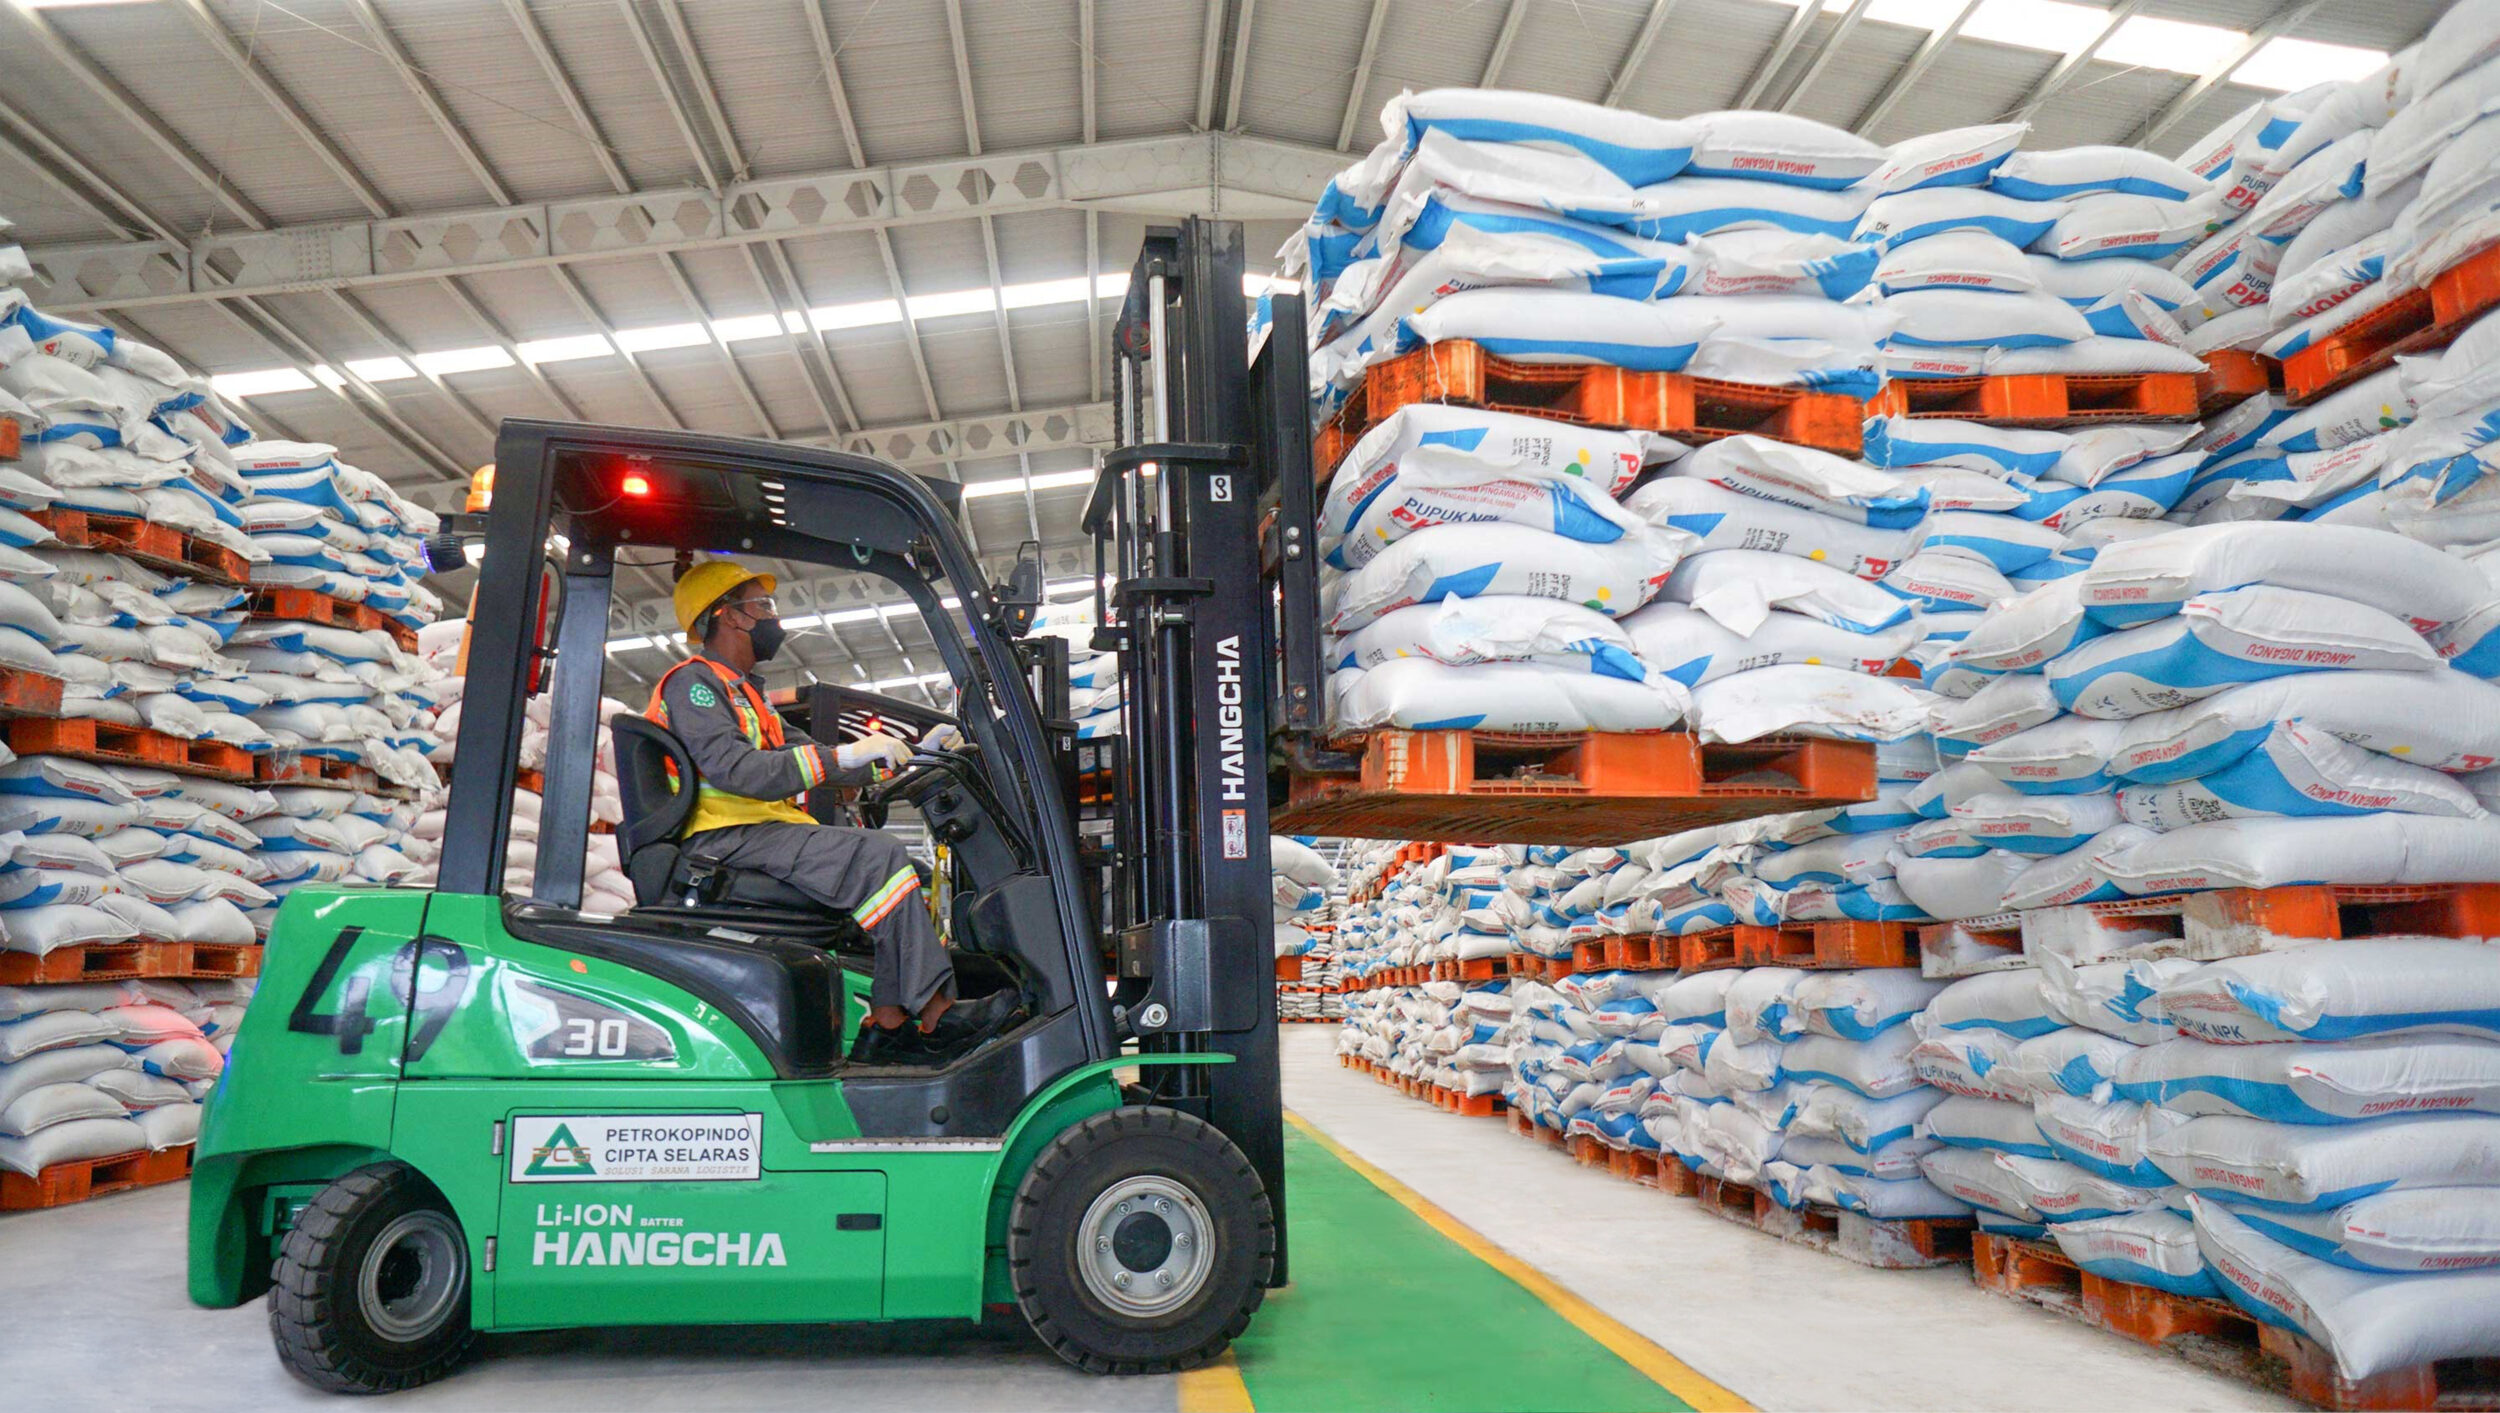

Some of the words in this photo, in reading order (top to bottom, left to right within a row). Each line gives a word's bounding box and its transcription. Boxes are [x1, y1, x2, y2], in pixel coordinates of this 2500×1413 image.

[1732, 157, 1774, 170] DIGANCU
[1776, 160, 1816, 175] JANGAN
[1953, 152, 1985, 167] JANGAN
[1924, 160, 1952, 177] DIGANCU
[2240, 175, 2276, 193] PUPU
[1926, 275, 1961, 284] DIGANCU
[1961, 276, 1992, 286] JANGAN
[2241, 273, 2272, 294] PUPU
[1911, 361, 1941, 372] DIGANCU
[1941, 364, 1969, 374] JANGAN
[1404, 497, 1467, 522] PUPUK
[1943, 589, 1976, 601] JANGAN
[2246, 643, 2304, 661] DIGANCU
[2304, 652, 2356, 665] JANGAN
[1217, 635, 1246, 801] HANGCHA
[2130, 747, 2161, 766] DIGANCU
[2161, 739, 2187, 759] JANGAN
[2349, 790, 2397, 807] JANGAN
[288, 925, 470, 1063] 49
[2168, 1012, 2210, 1034] PUPUK
[2212, 1024, 2246, 1040] NPK
[564, 1018, 628, 1056] 30
[2359, 1097, 2416, 1114] DIGANCU
[2418, 1096, 2475, 1108] JANGAN
[606, 1128, 750, 1142] PETROKOPINDO
[532, 1147, 591, 1163] PCS
[605, 1149, 658, 1163] CIPTA
[664, 1148, 750, 1162] SELARAS
[604, 1167, 644, 1175] SOLUSI
[650, 1166, 690, 1175] SARANA
[696, 1166, 750, 1175] LOGISTIK
[2195, 1167, 2228, 1184] DIGANCU
[2229, 1173, 2265, 1191] JANGAN
[536, 1204, 633, 1227] Li-ION
[640, 1218, 684, 1227] BATTER
[532, 1232, 788, 1267] HANGCHA
[2219, 1258, 2260, 1296] DIGANCU
[2259, 1282, 2296, 1314] JANGAN
